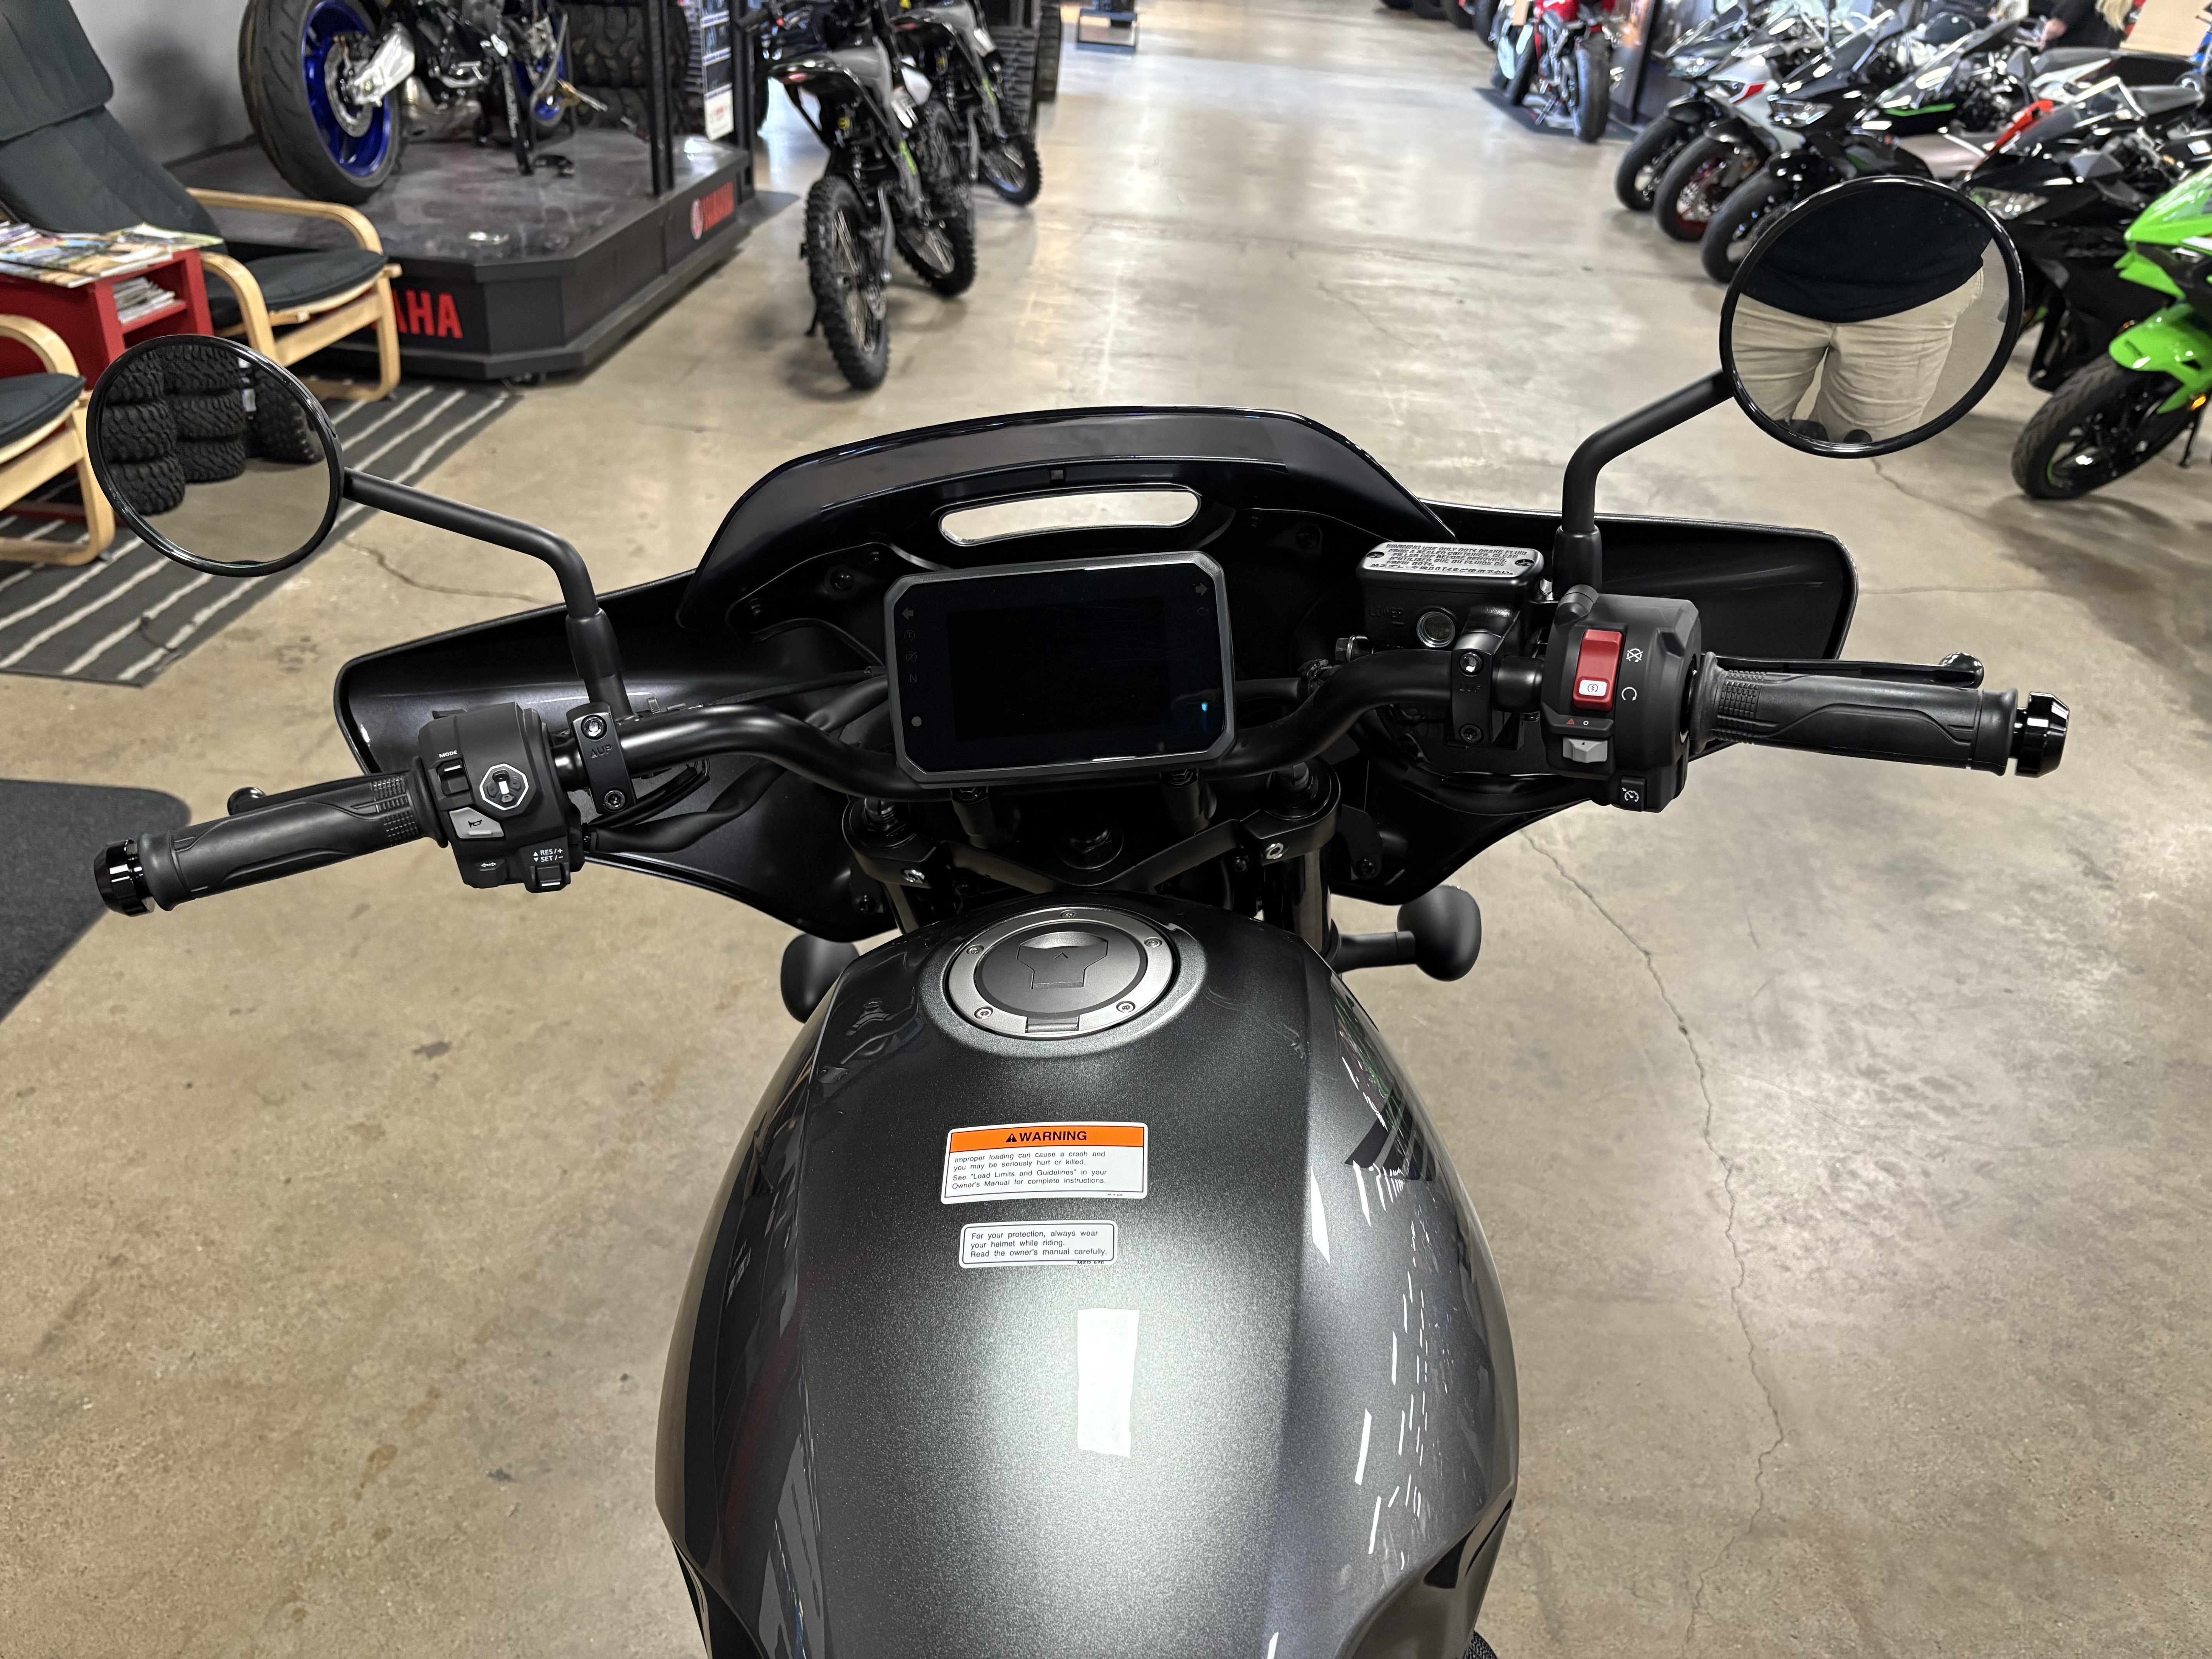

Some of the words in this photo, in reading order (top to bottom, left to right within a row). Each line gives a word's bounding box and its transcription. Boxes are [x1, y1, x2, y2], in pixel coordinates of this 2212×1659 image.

[1019, 1131, 1087, 1142] WARNING
[1008, 1231, 1045, 1239] protection,
[1074, 1248, 1107, 1256] carefully.
